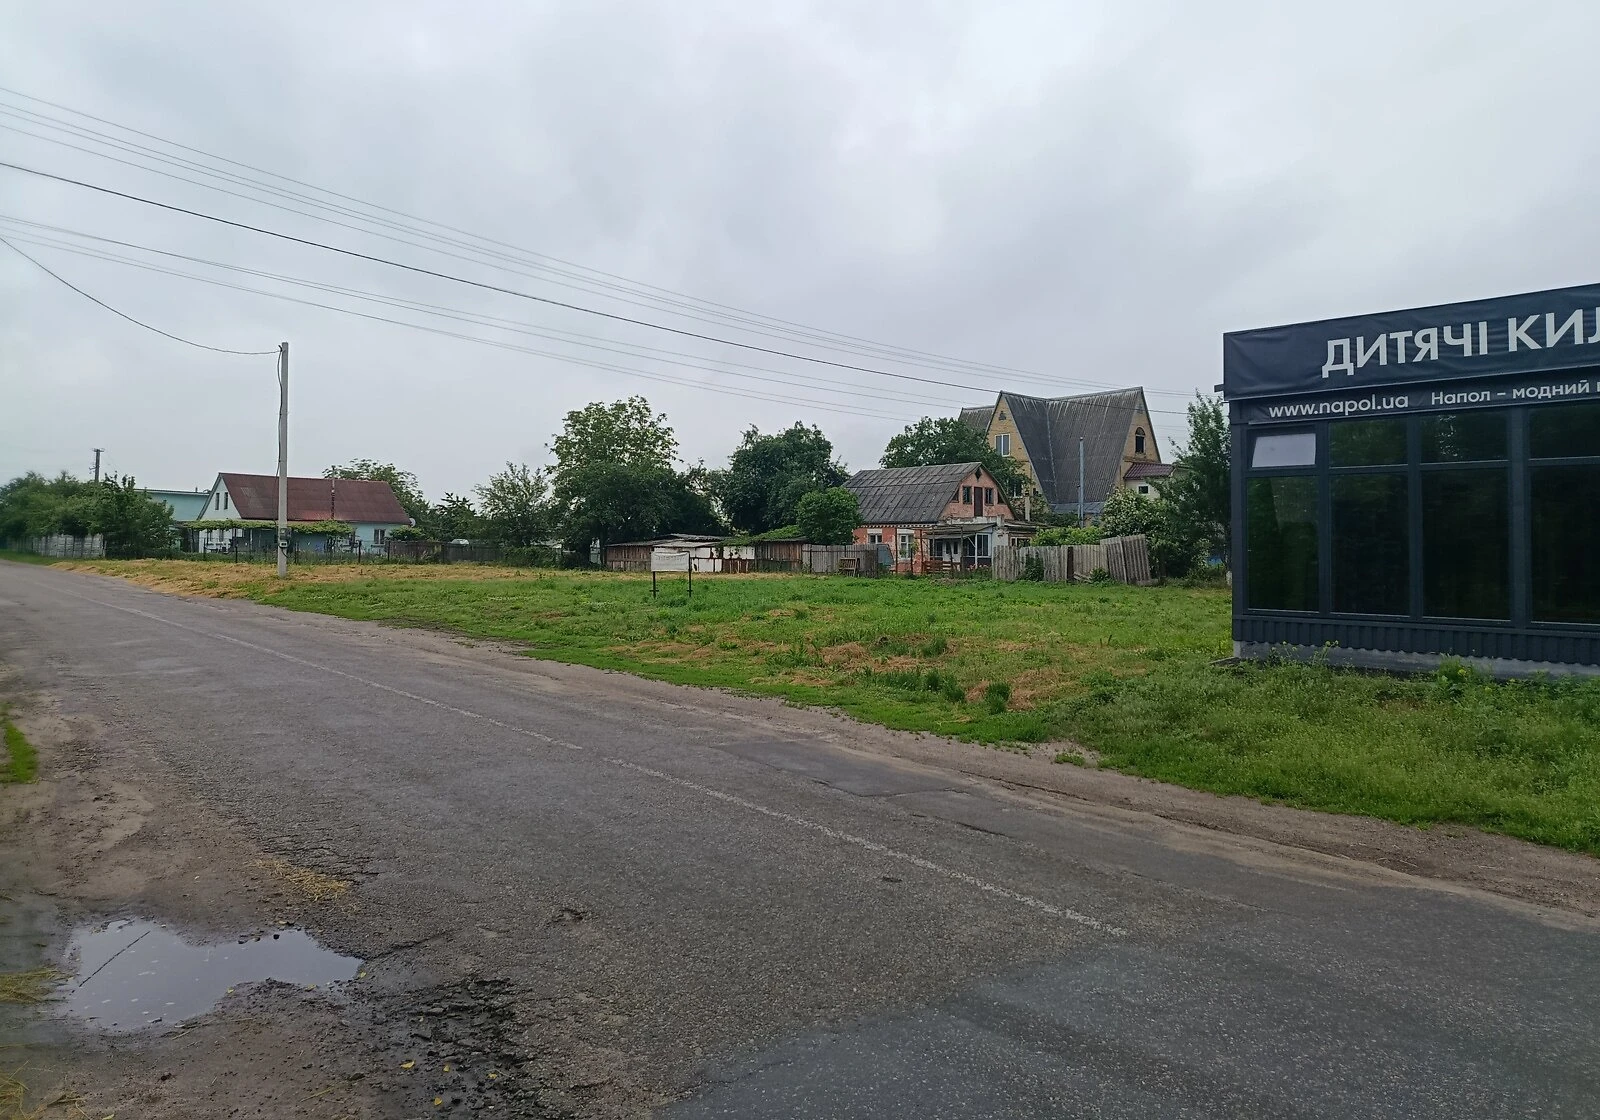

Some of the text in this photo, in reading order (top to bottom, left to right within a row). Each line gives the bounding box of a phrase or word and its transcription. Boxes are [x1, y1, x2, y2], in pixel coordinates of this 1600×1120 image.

[1321, 321, 1489, 379] ДИТЯЧІ
[1431, 390, 1491, 405] Напол
[1512, 379, 1590, 399] модний
[1268, 393, 1410, 418] www.napol.ua
